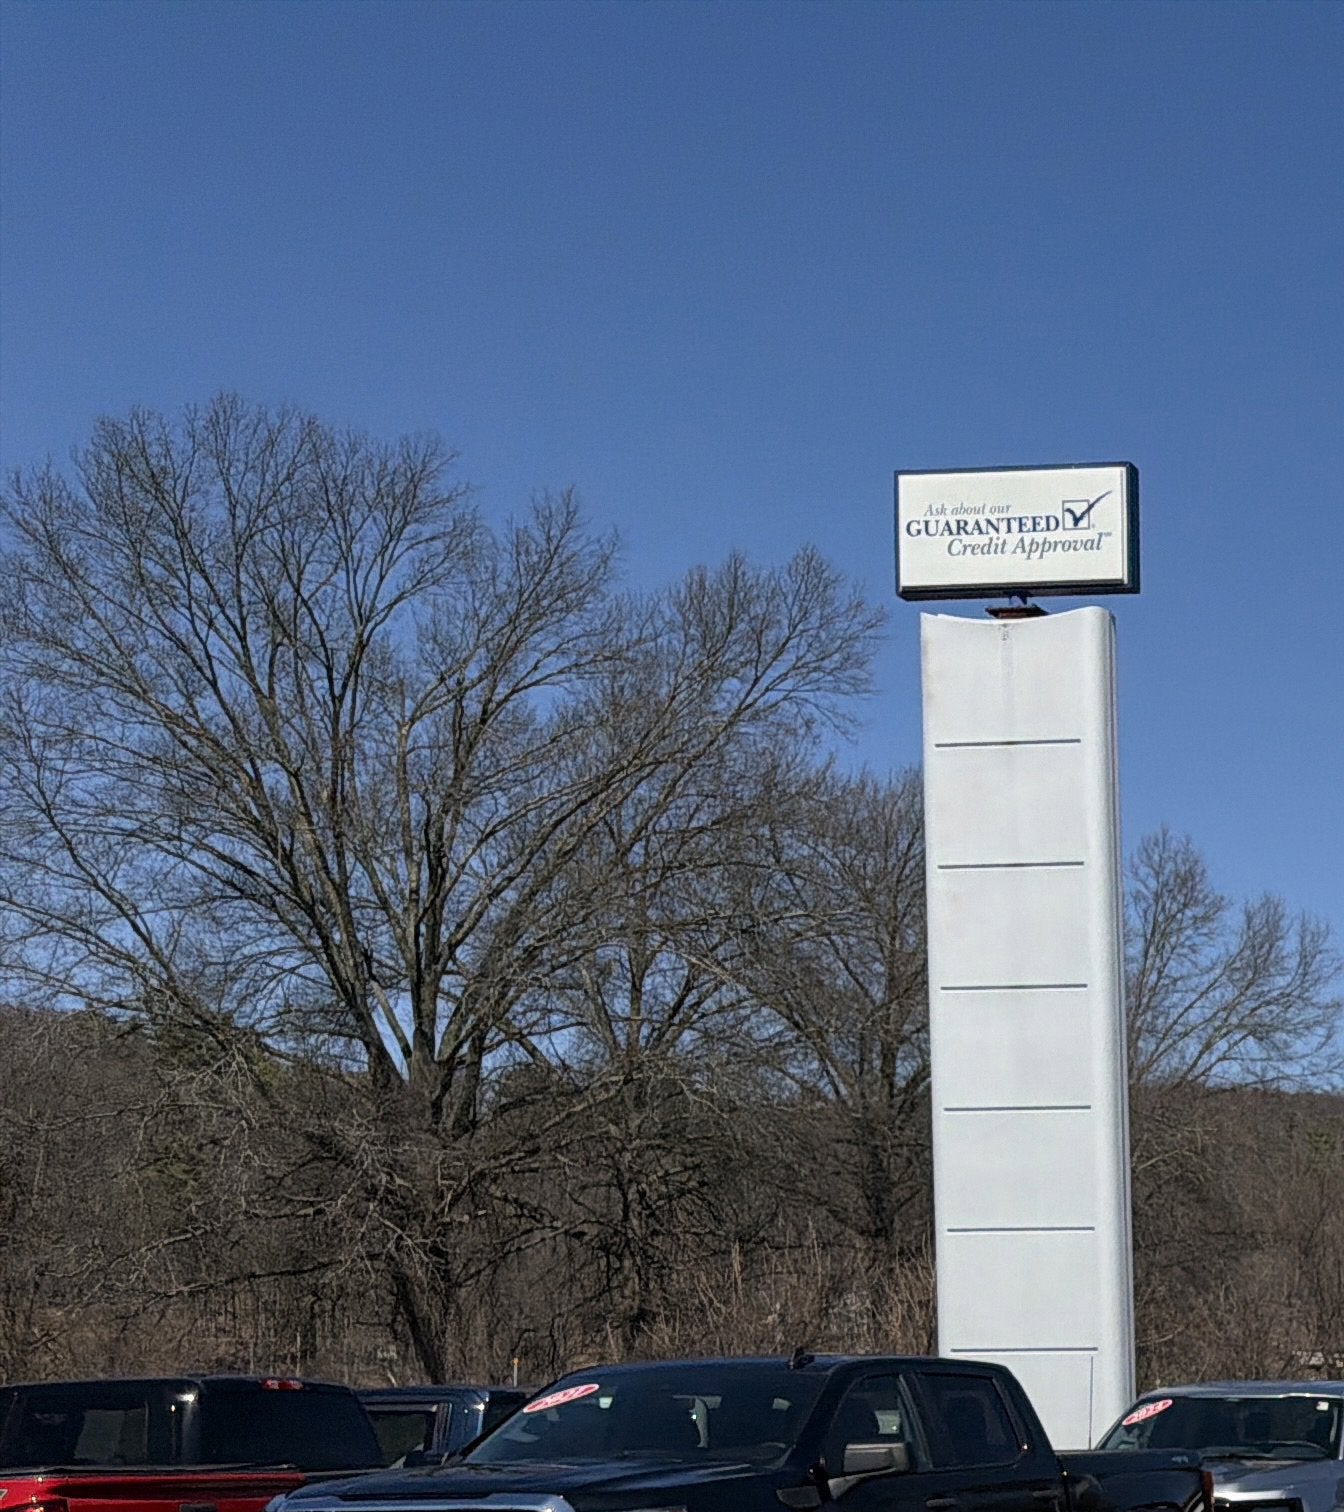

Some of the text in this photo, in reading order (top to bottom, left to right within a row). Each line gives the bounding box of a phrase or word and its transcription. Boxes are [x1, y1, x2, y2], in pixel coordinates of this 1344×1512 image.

[924, 502, 1012, 517] Ask about our
[905, 515, 1060, 537] GUARANTEED
[947, 531, 1104, 561] Credit Approval
